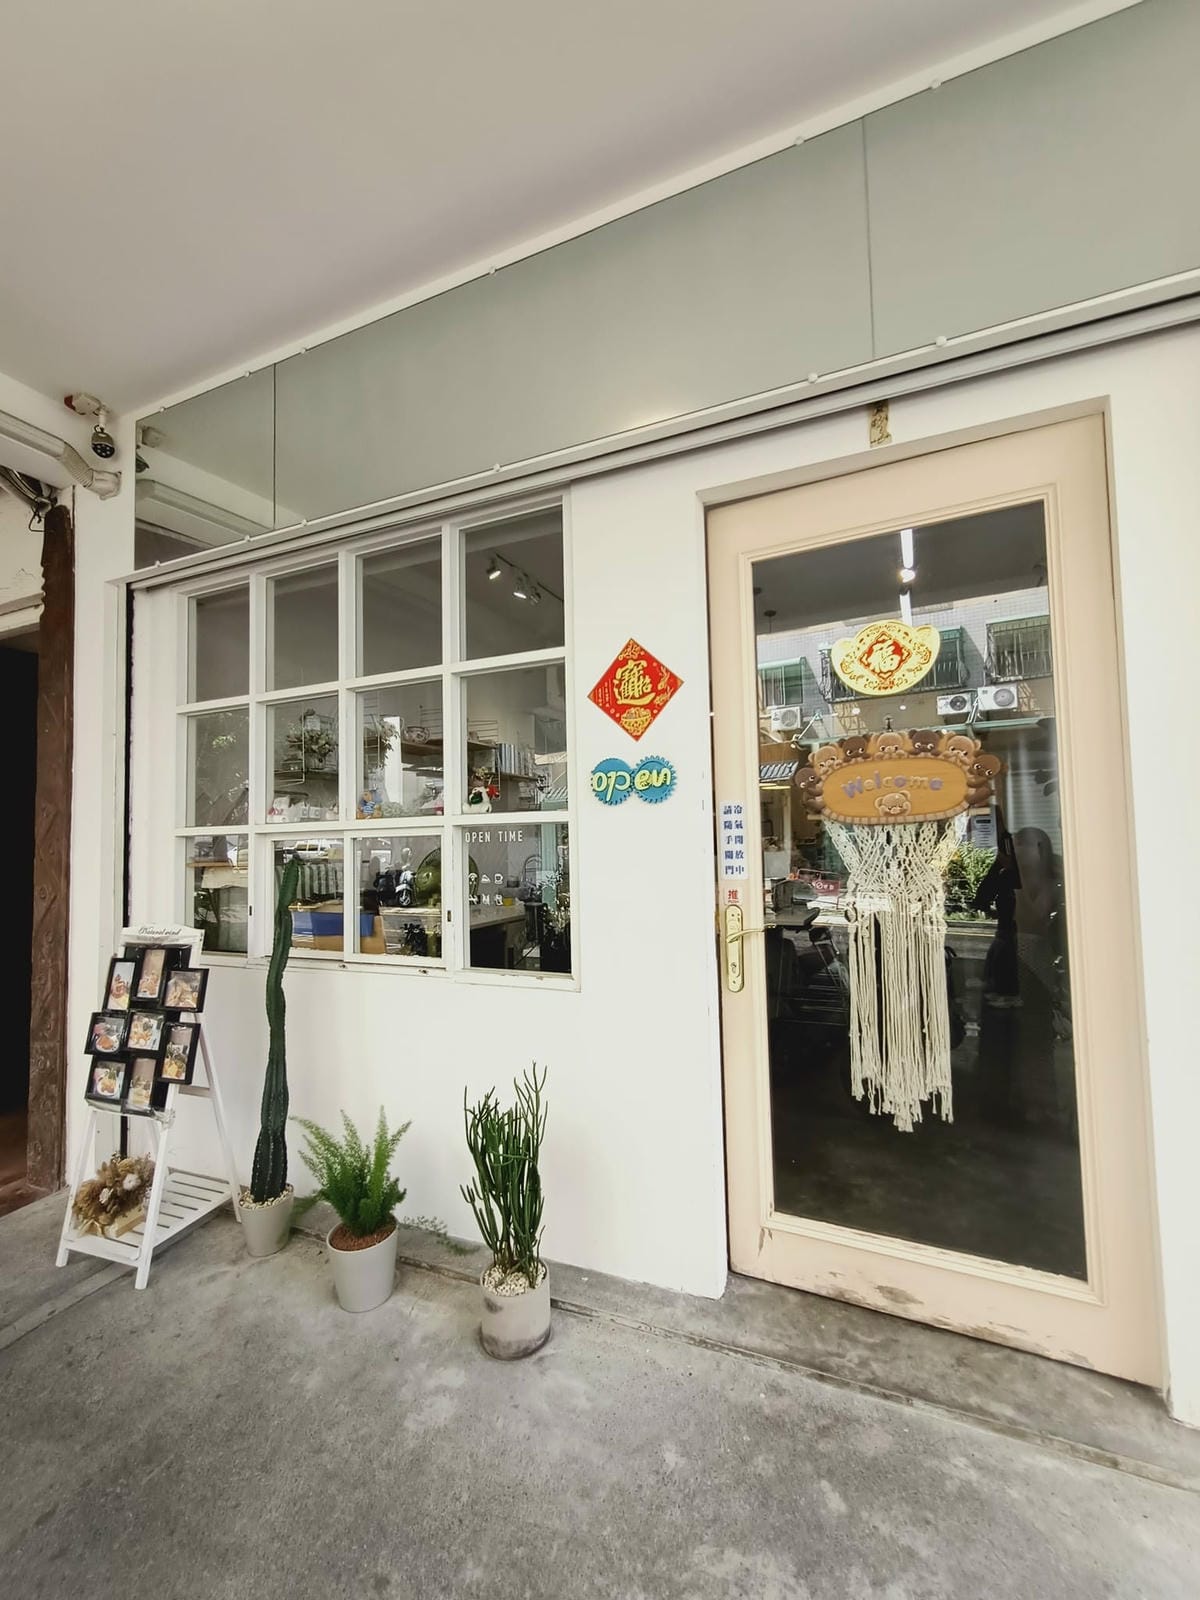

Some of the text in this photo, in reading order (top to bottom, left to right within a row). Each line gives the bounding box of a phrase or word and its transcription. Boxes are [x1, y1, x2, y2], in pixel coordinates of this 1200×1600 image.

[592, 767, 671, 802] open
[465, 830, 523, 843] OPEN TIME
[733, 804, 745, 875] 冷氣開放中
